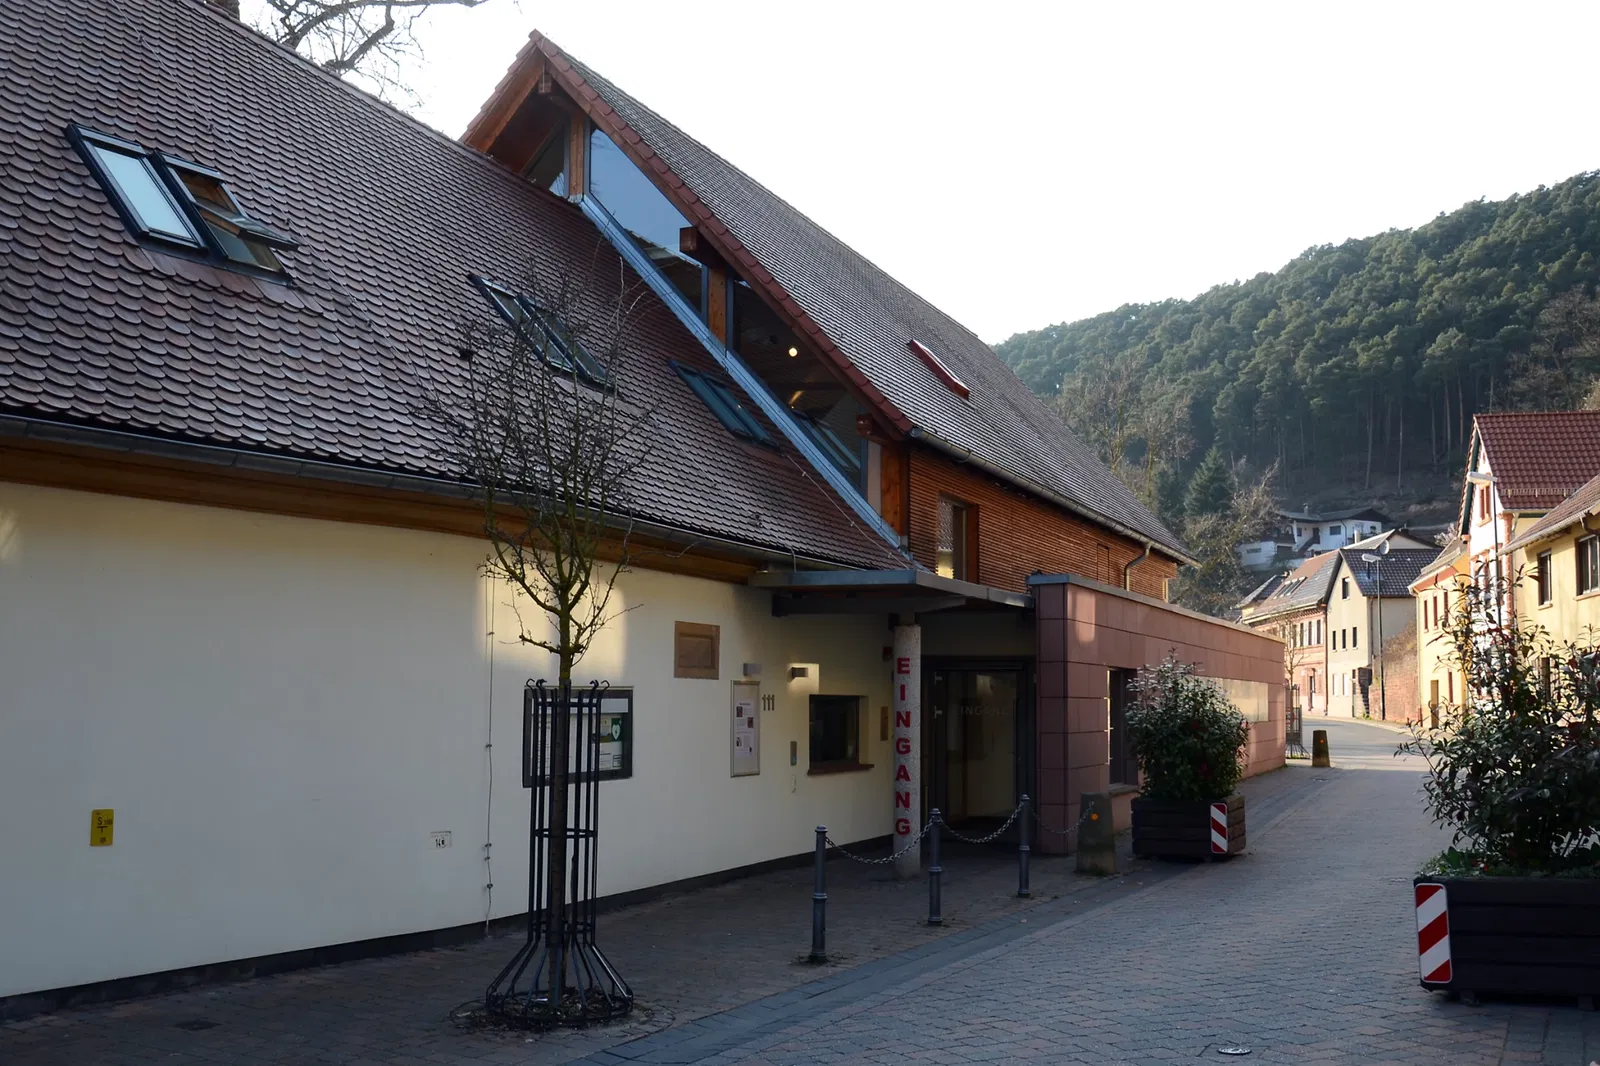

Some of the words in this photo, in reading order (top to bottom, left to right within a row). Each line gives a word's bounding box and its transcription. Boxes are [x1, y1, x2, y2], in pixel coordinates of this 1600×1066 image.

[762, 694, 775, 711] 111
[956, 705, 1010, 716] INGANG
[895, 657, 911, 836] EINGANG
